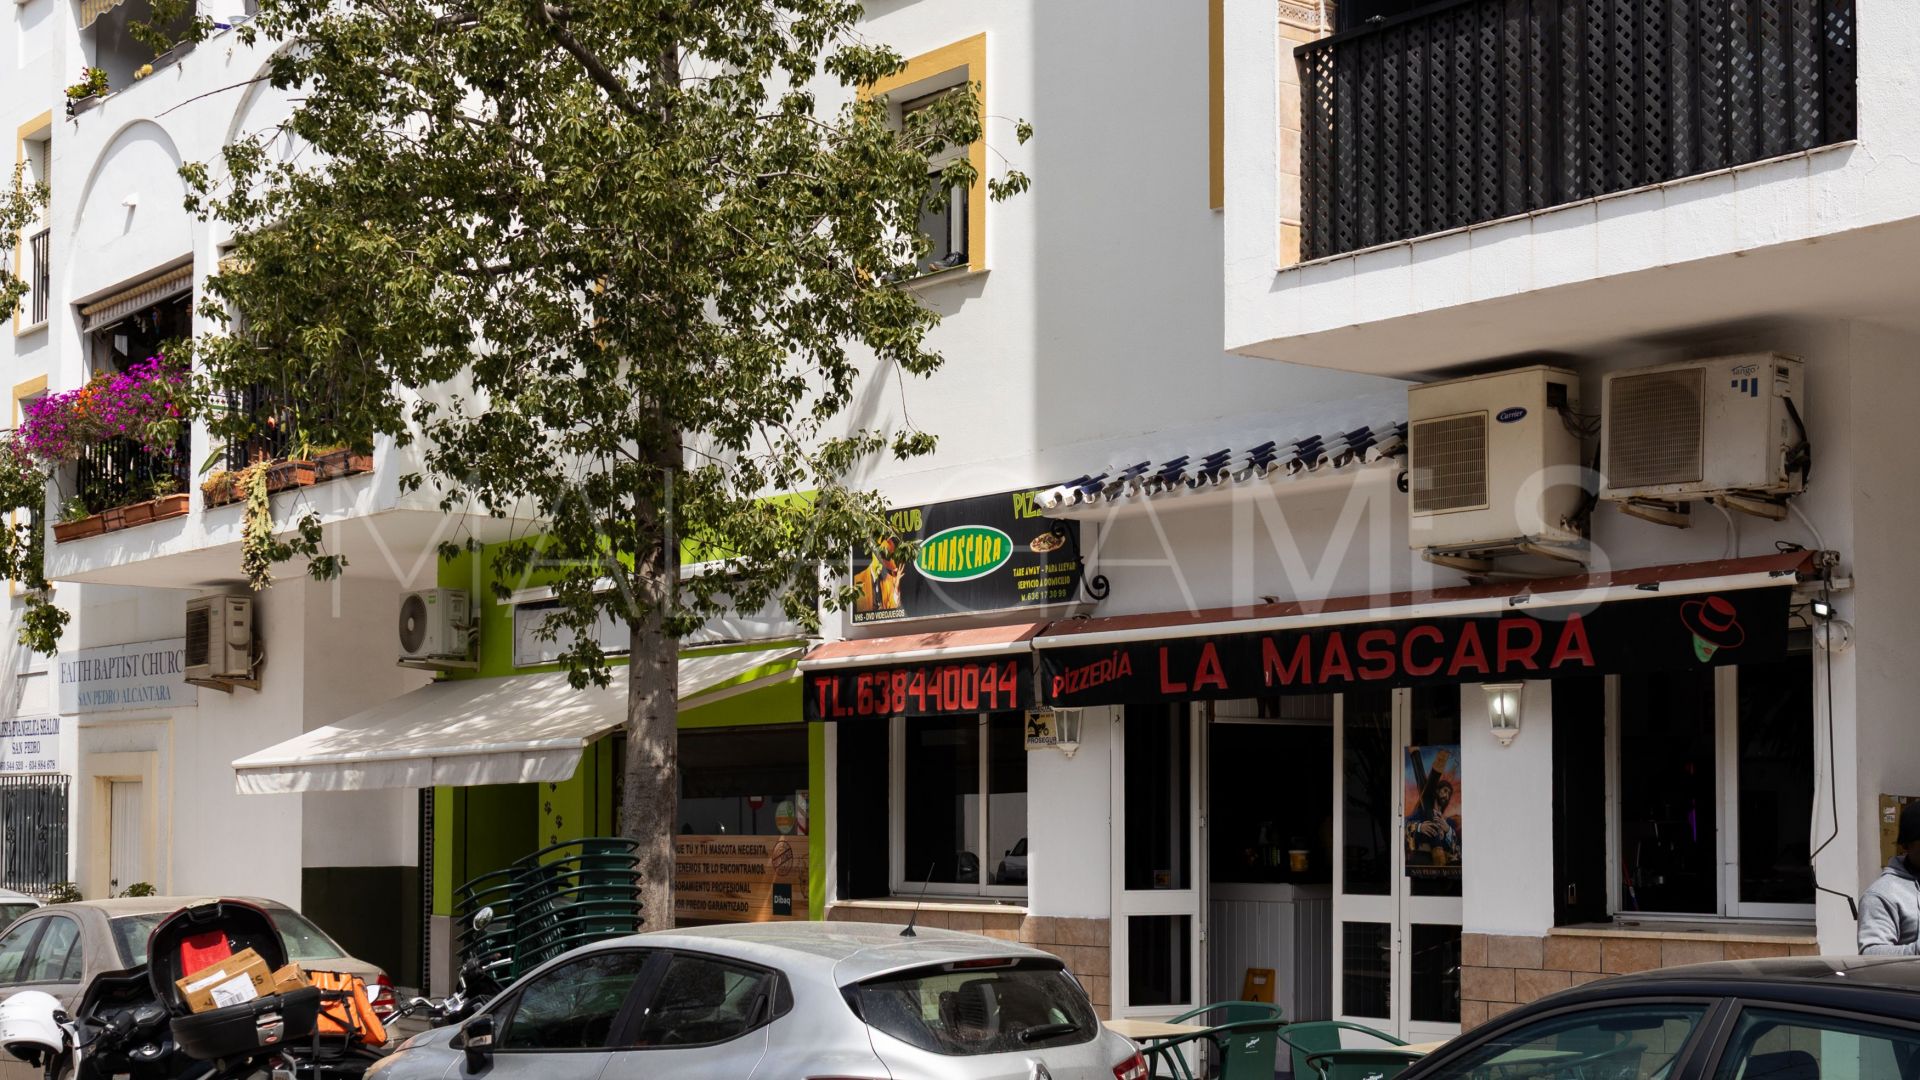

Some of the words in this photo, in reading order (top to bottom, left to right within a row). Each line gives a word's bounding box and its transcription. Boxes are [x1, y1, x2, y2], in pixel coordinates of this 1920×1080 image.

[1012, 490, 1042, 519] PIZ
[921, 542, 936, 571] LA
[938, 534, 1001, 571] MASCARA
[1013, 568, 1025, 577] TAKE
[1025, 566, 1040, 576] AWAY
[1045, 564, 1057, 573] PARA
[1058, 562, 1076, 571] LLEVAR
[1018, 579, 1039, 590] SERVICIO
[1044, 576, 1071, 587] DOMICILIO
[854, 613, 863, 622] VHS
[866, 612, 875, 621] DVD
[875, 609, 905, 620] VIDEOJUEGOS
[1159, 642, 1228, 694] LA
[1262, 612, 1596, 687] MASCARA
[61, 659, 91, 684] FAITH
[94, 654, 139, 681] BAPTIST
[142, 649, 186, 677] CHURC
[78, 690, 94, 706] SAN
[95, 688, 119, 705] PEDRO
[122, 685, 171, 704] ALCANTARA
[40, 718, 60, 735] SHALOM
[12, 742, 22, 754] SAN
[24, 741, 40, 754] PEDRO
[709, 844, 737, 855] MASCOTA
[702, 863, 710, 874] TE
[711, 863, 719, 874] LO
[711, 882, 752, 893] PROFESIONAL
[686, 900, 707, 911] PRECIO
[707, 900, 749, 912] GARANTIZADO
[774, 895, 791, 907] Dibaq
